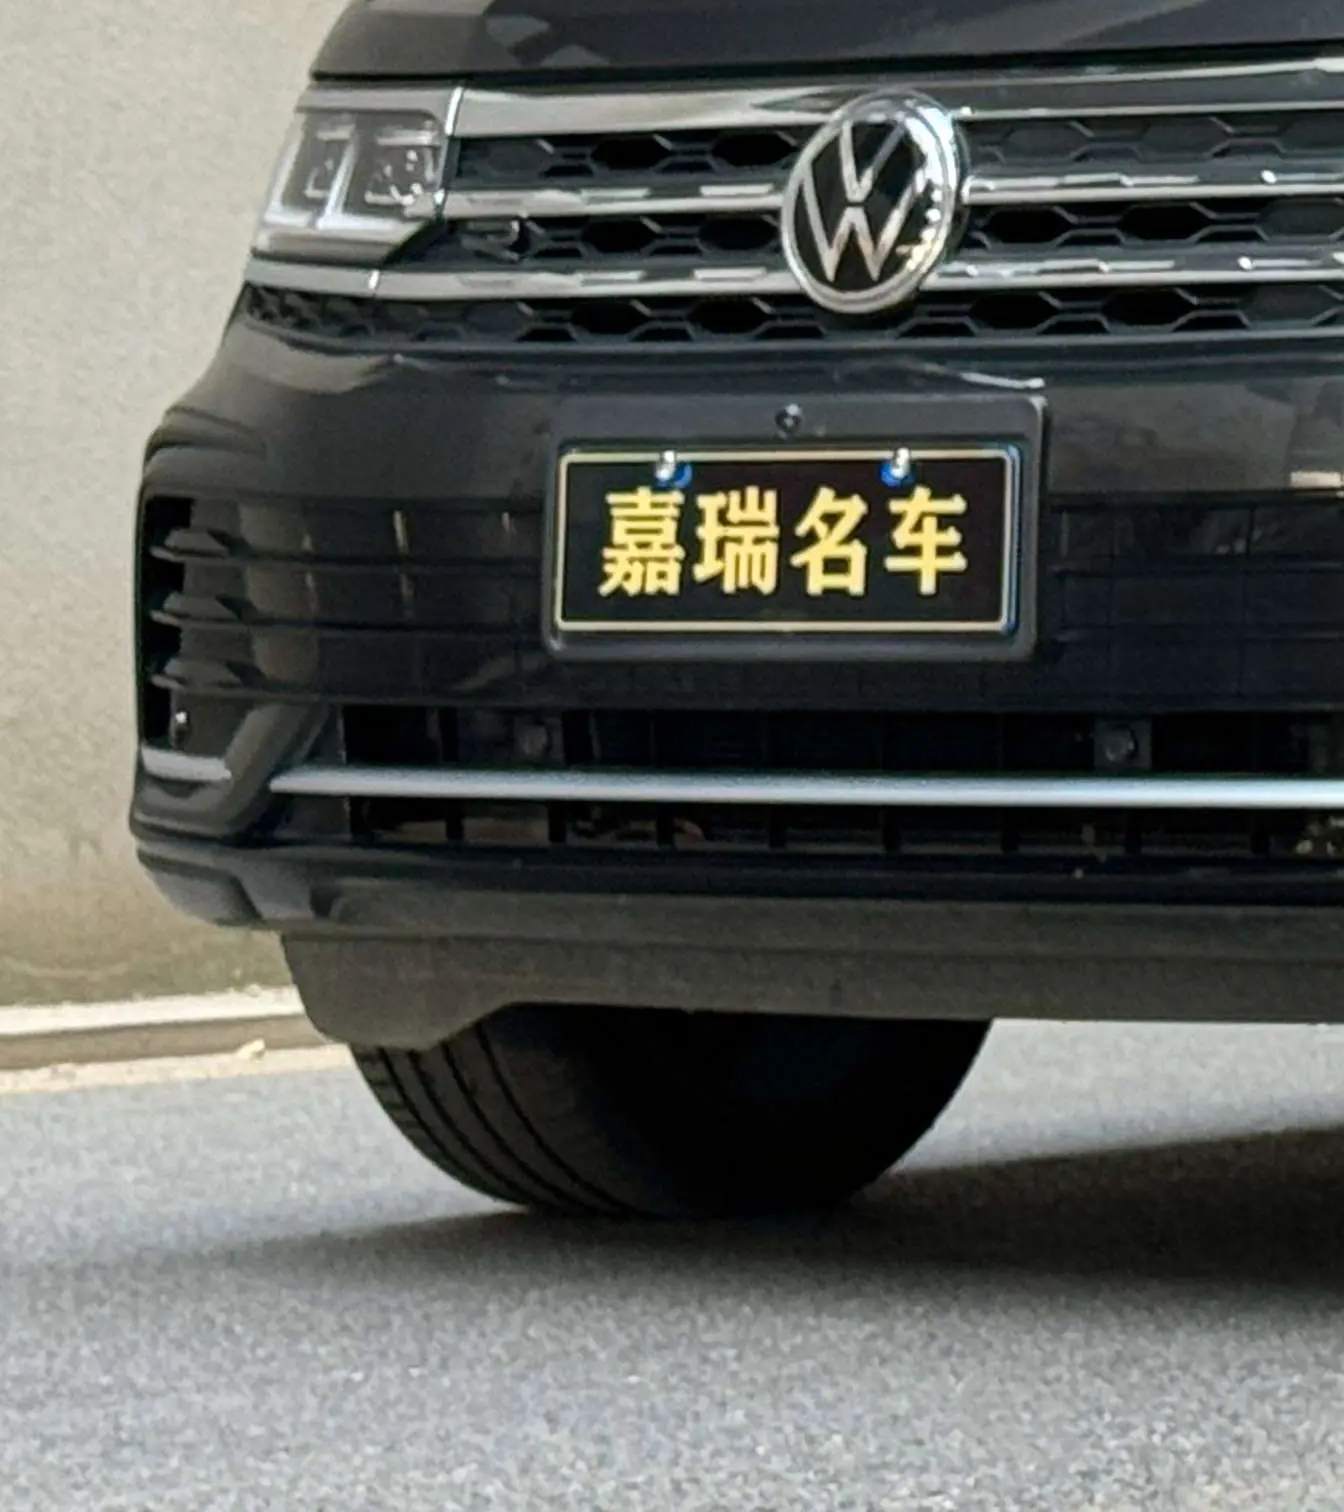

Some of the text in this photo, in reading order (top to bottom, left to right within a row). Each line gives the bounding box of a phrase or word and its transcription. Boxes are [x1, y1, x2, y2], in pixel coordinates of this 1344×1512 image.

[788, 100, 946, 302] VW
[599, 485, 967, 597] 嘉瑞名车
